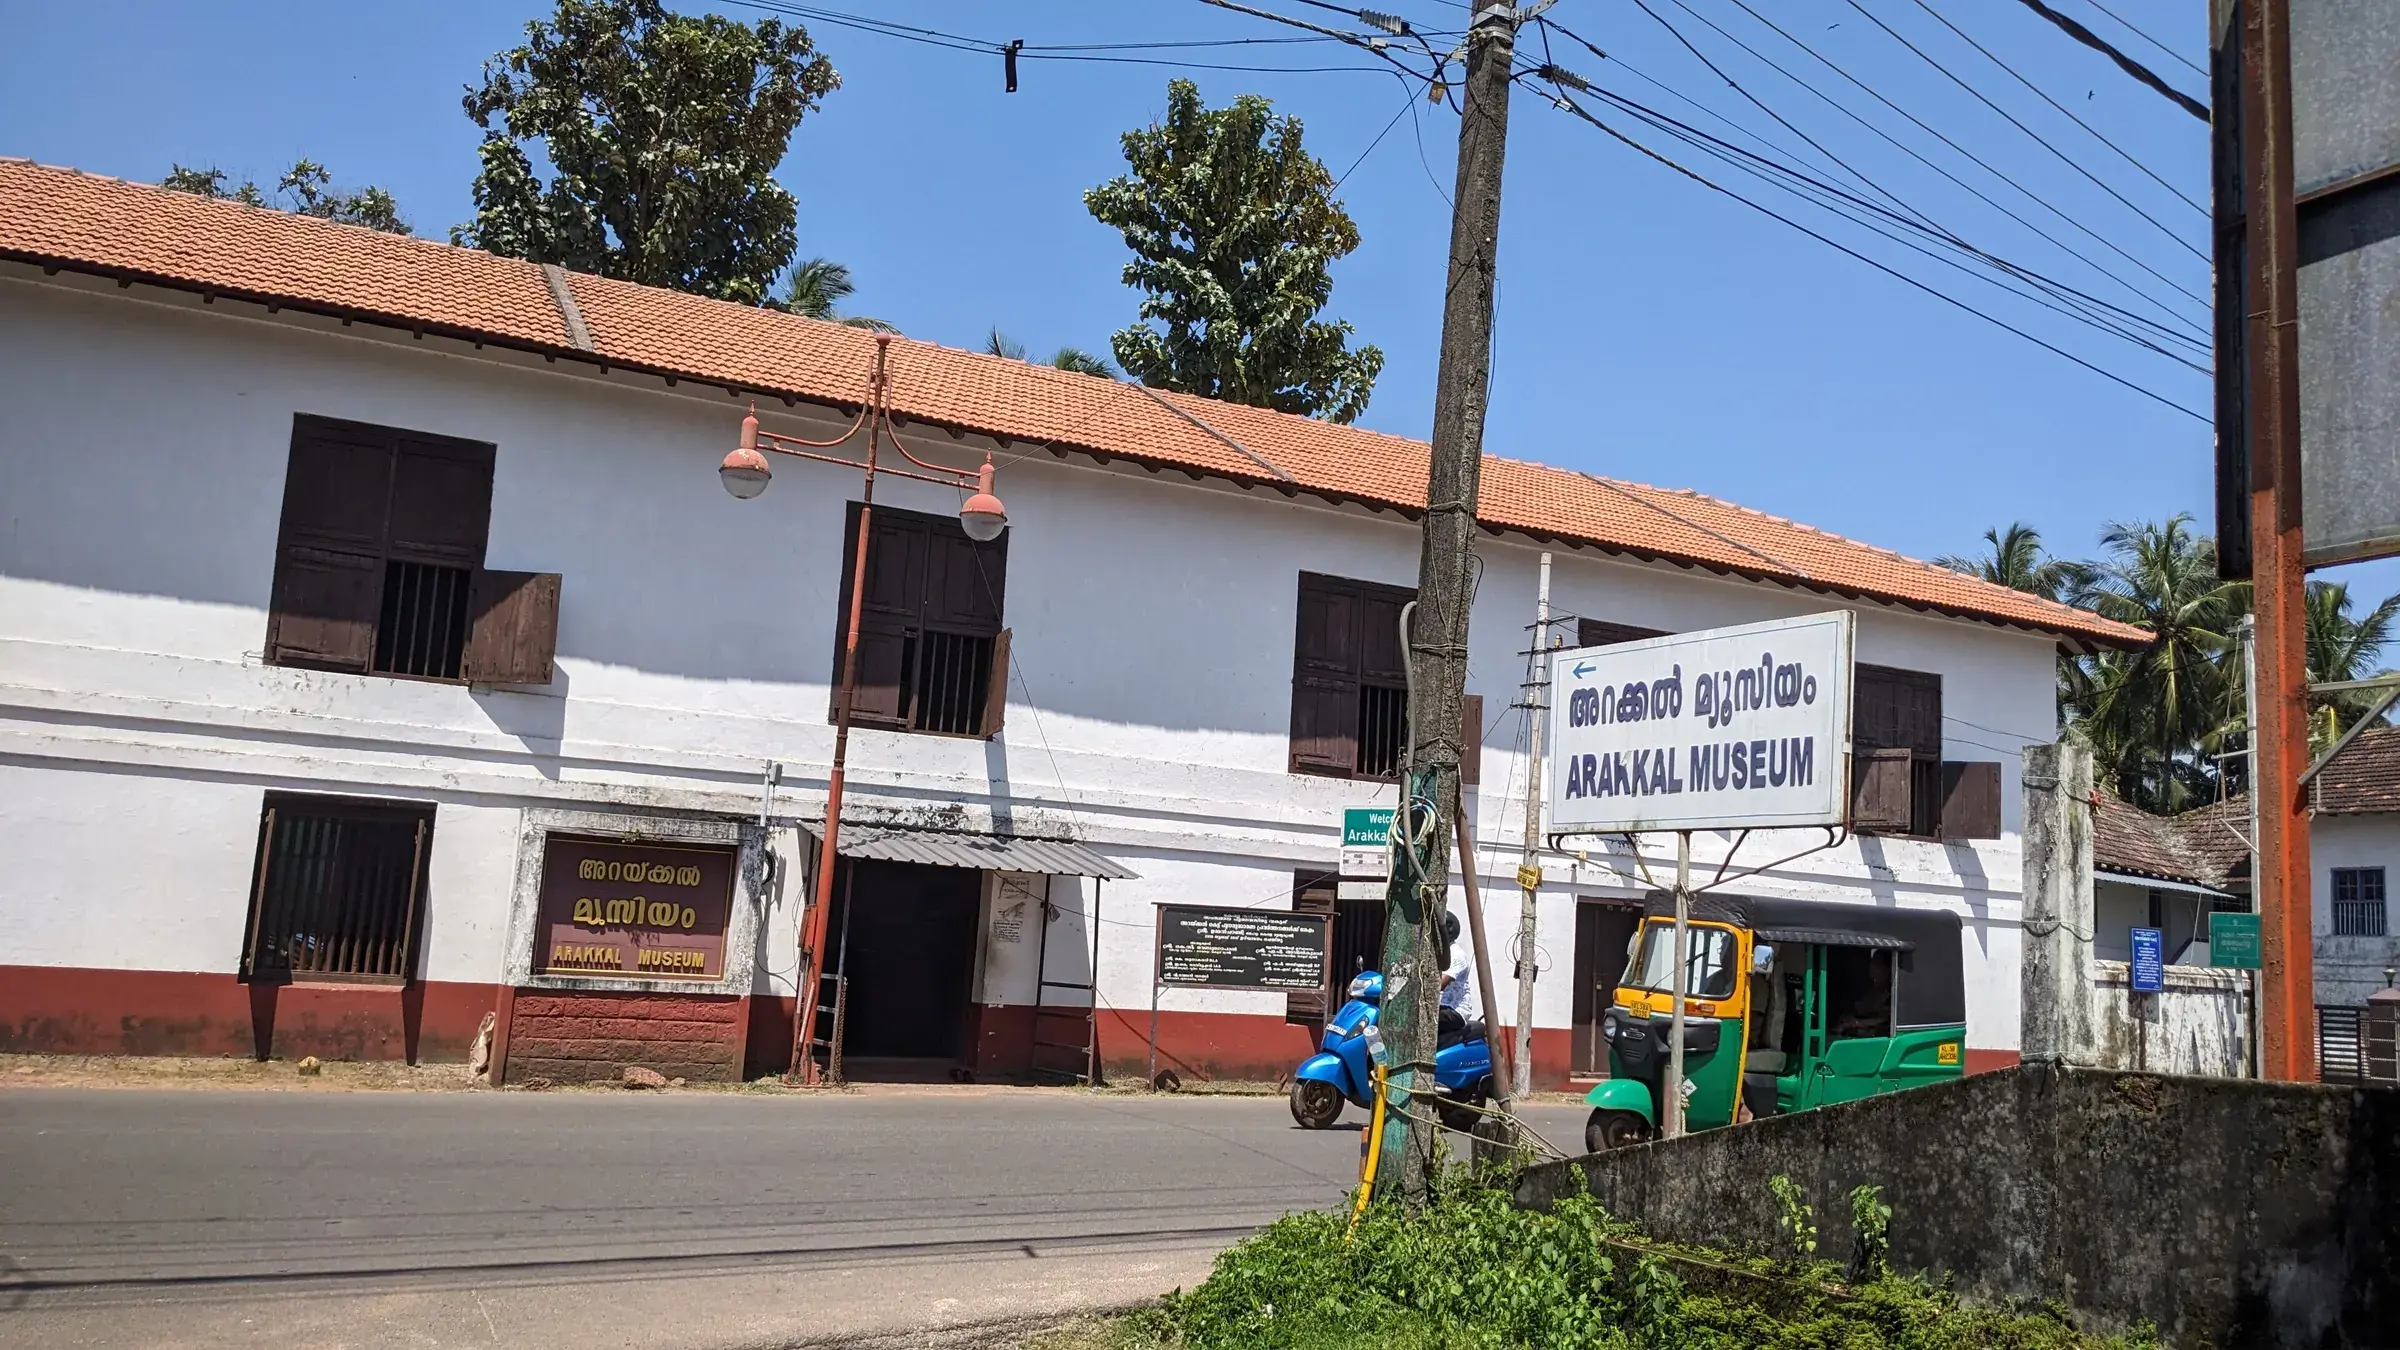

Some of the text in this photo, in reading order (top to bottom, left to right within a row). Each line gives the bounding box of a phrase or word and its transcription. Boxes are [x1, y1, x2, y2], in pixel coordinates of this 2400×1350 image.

[1569, 664, 1682, 727] അറക്കൽ
[1566, 736, 1813, 799] ARAKKAL MUSEUM
[1348, 829, 1387, 842] Arakka
[554, 946, 705, 967] ARAKKAL MUSEUM
